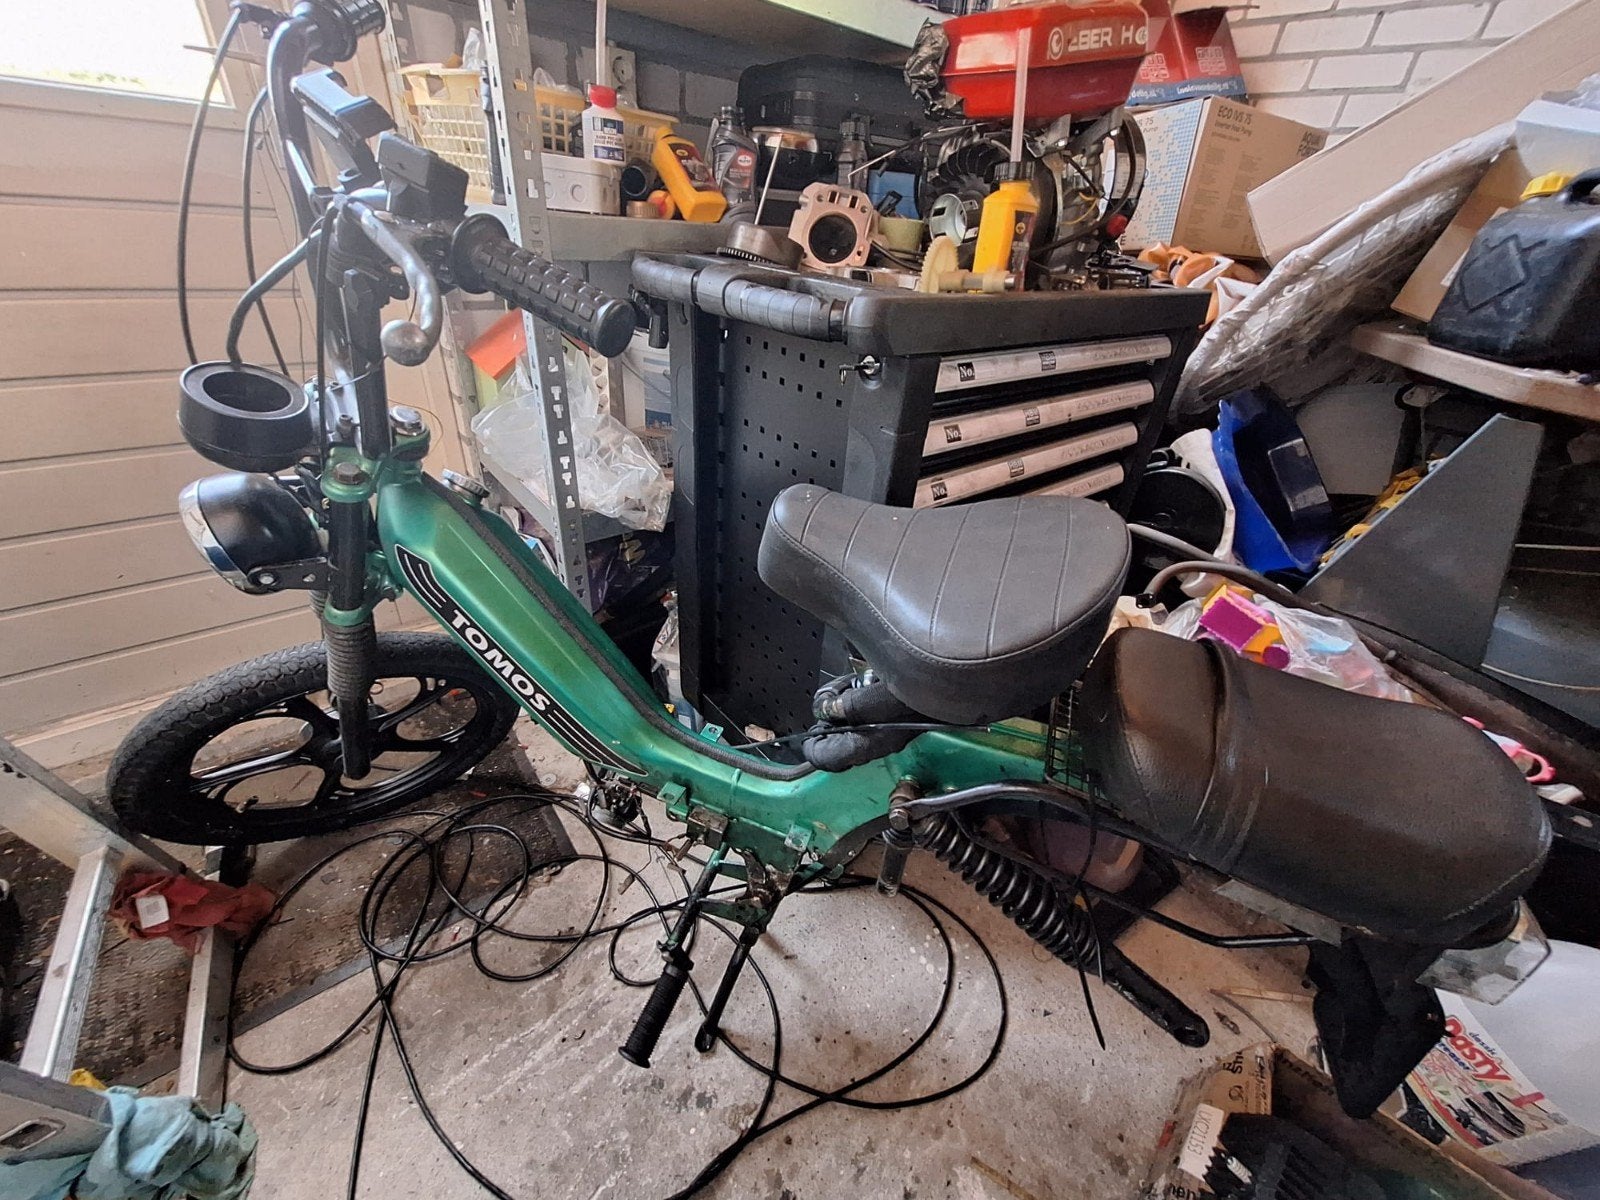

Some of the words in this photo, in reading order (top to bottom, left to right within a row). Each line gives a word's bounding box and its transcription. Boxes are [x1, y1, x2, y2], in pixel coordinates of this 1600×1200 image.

[1217, 105, 1232, 120] ECO
[960, 368, 976, 379] No.
[945, 427, 962, 439] No.
[450, 609, 551, 712] TOMOS
[1438, 1043, 1471, 1071] reaser
